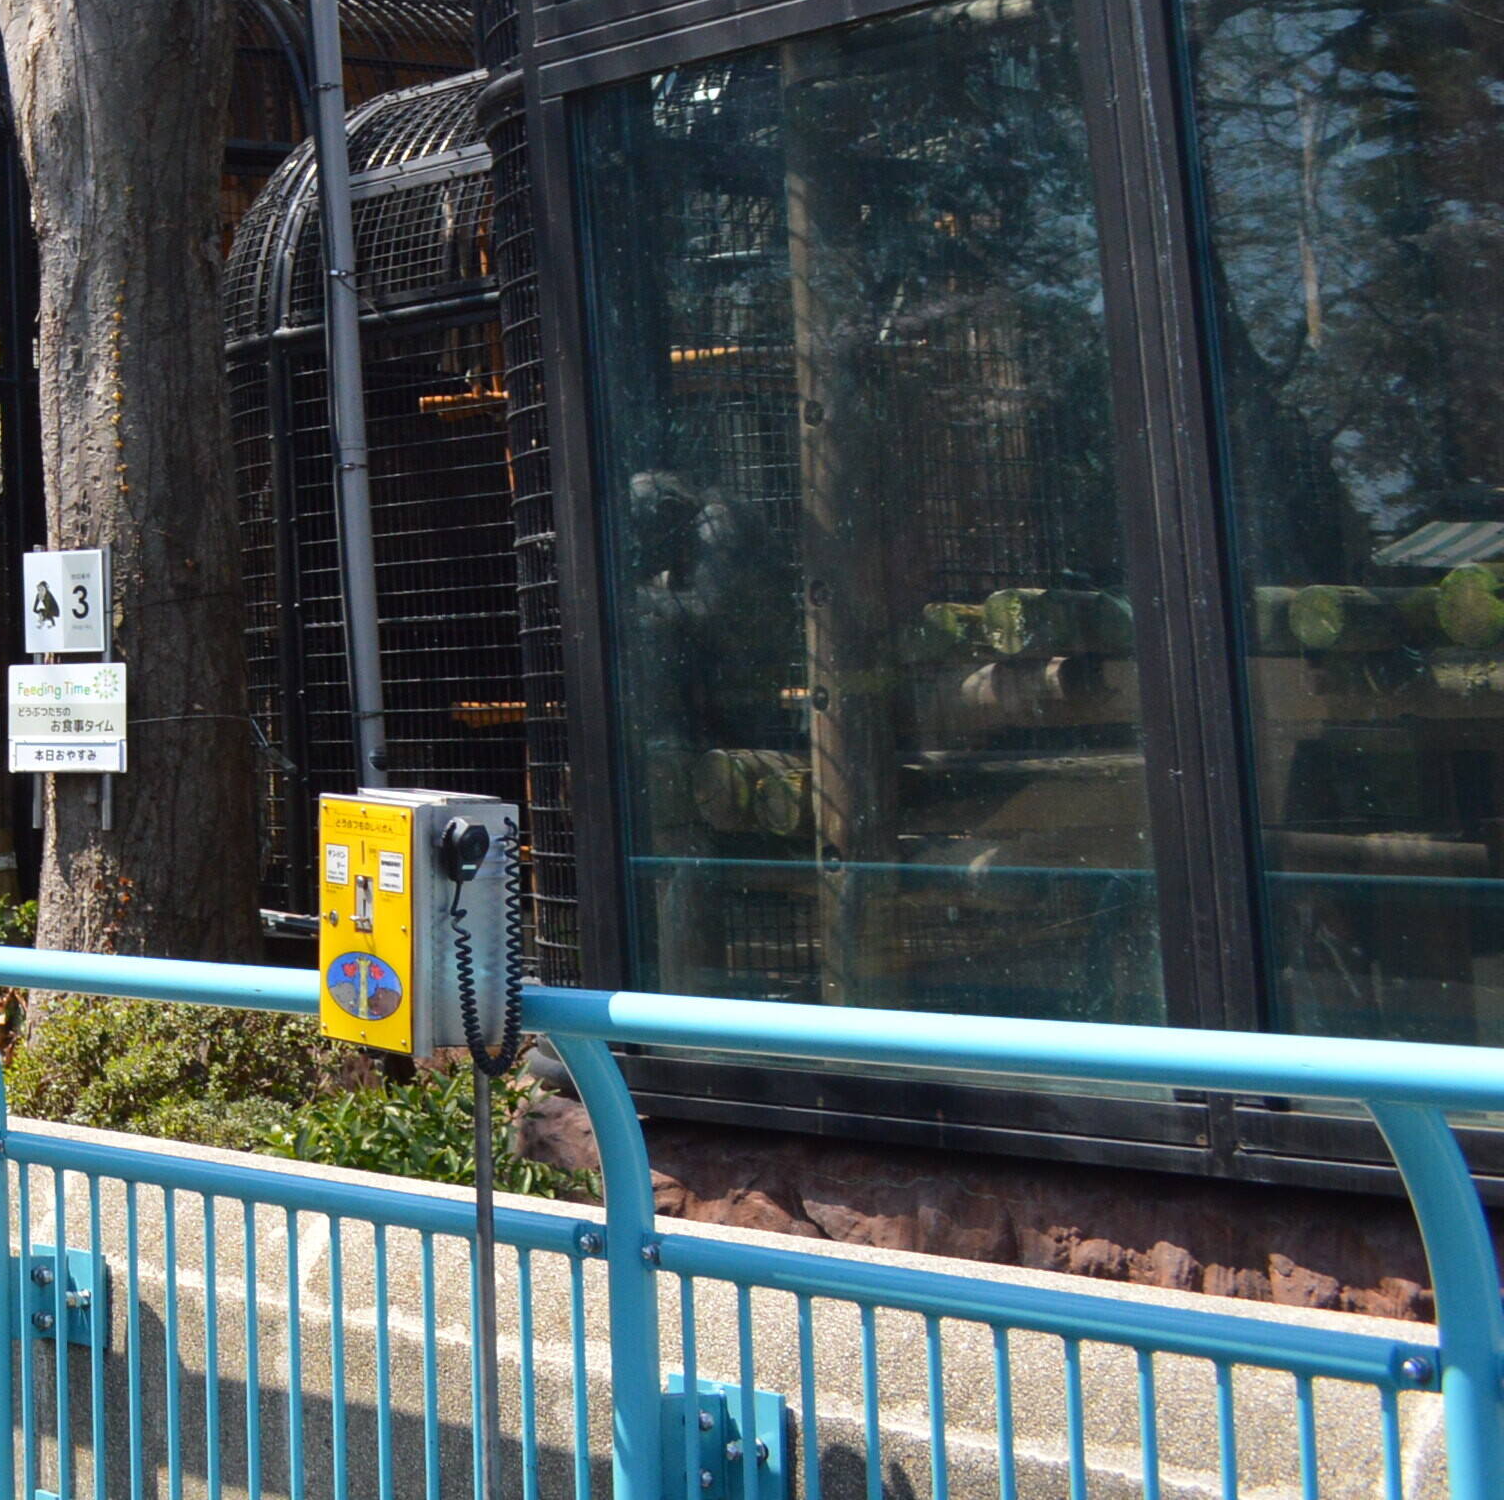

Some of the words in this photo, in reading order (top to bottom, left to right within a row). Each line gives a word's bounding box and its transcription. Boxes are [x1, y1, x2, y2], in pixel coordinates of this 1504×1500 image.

[71, 584, 90, 620] 3
[17, 681, 62, 700] Feeding
[64, 681, 91, 696] Time
[17, 706, 71, 718] どうぶつたちの
[50, 719, 114, 733] お食事タイム
[34, 749, 97, 762] 本日おやすみ
